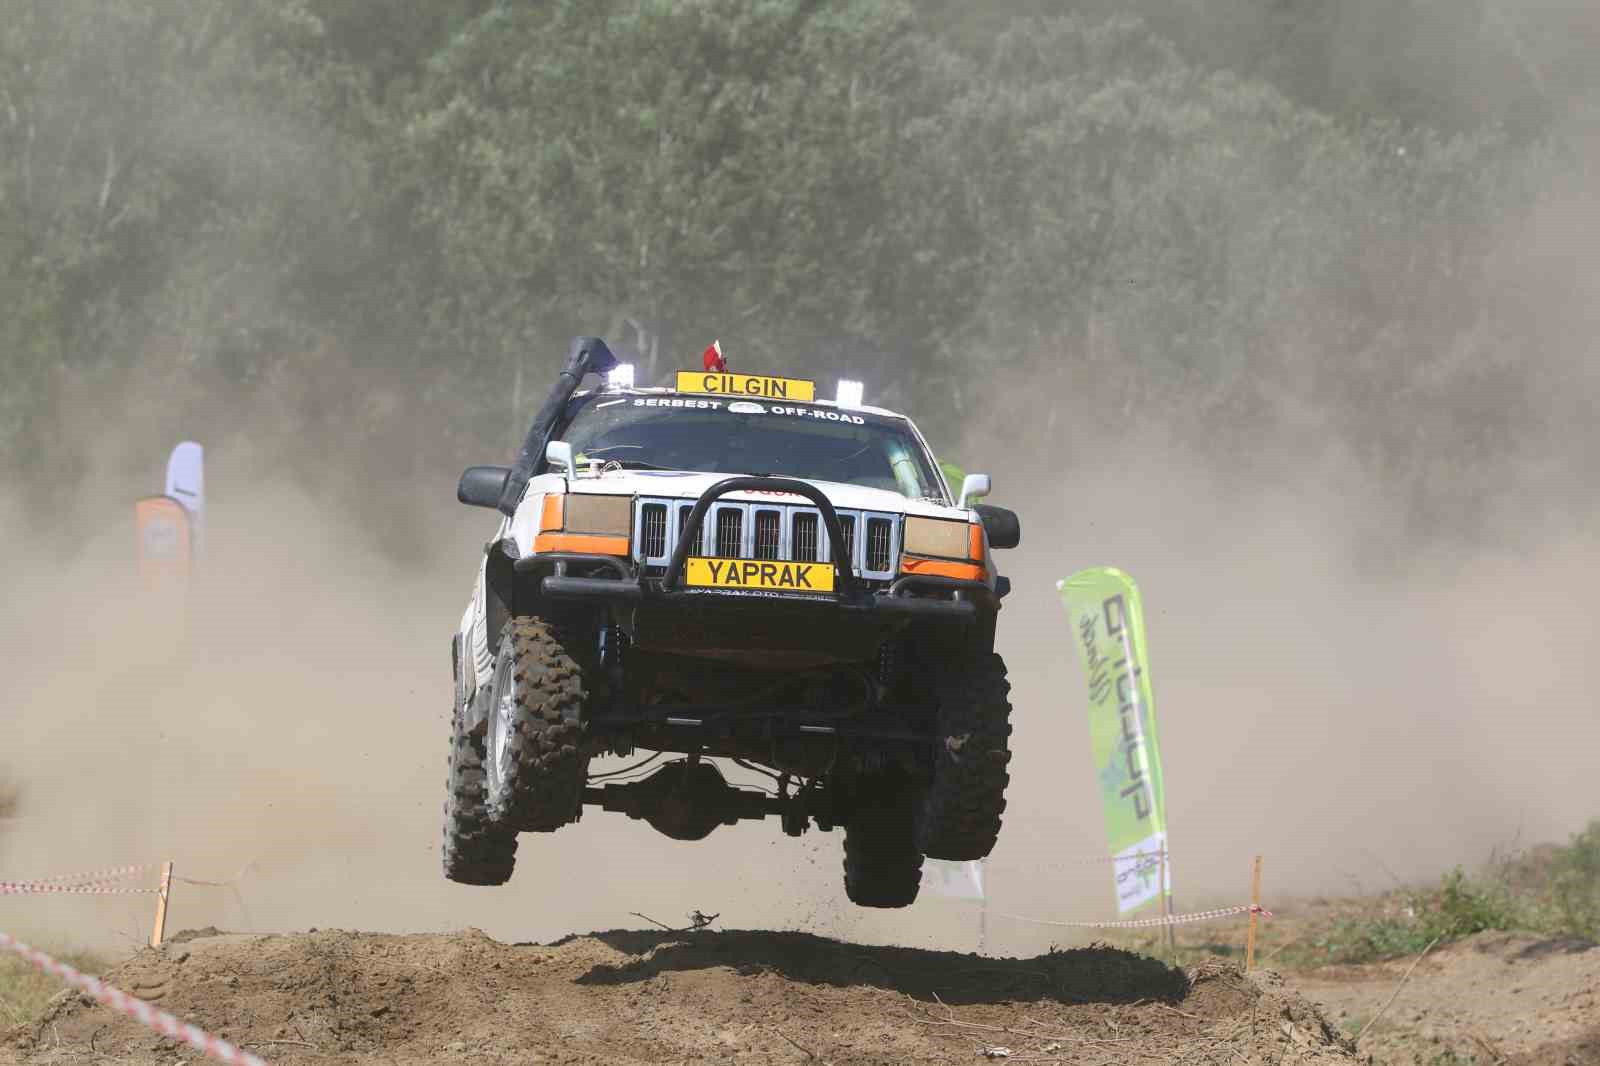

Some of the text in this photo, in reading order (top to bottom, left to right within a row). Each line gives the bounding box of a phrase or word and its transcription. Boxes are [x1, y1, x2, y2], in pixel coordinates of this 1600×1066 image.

[703, 375, 787, 397] CILGIN
[633, 398, 864, 425] SERBEST OFF-ROAD
[708, 561, 812, 587] YAPRAK
